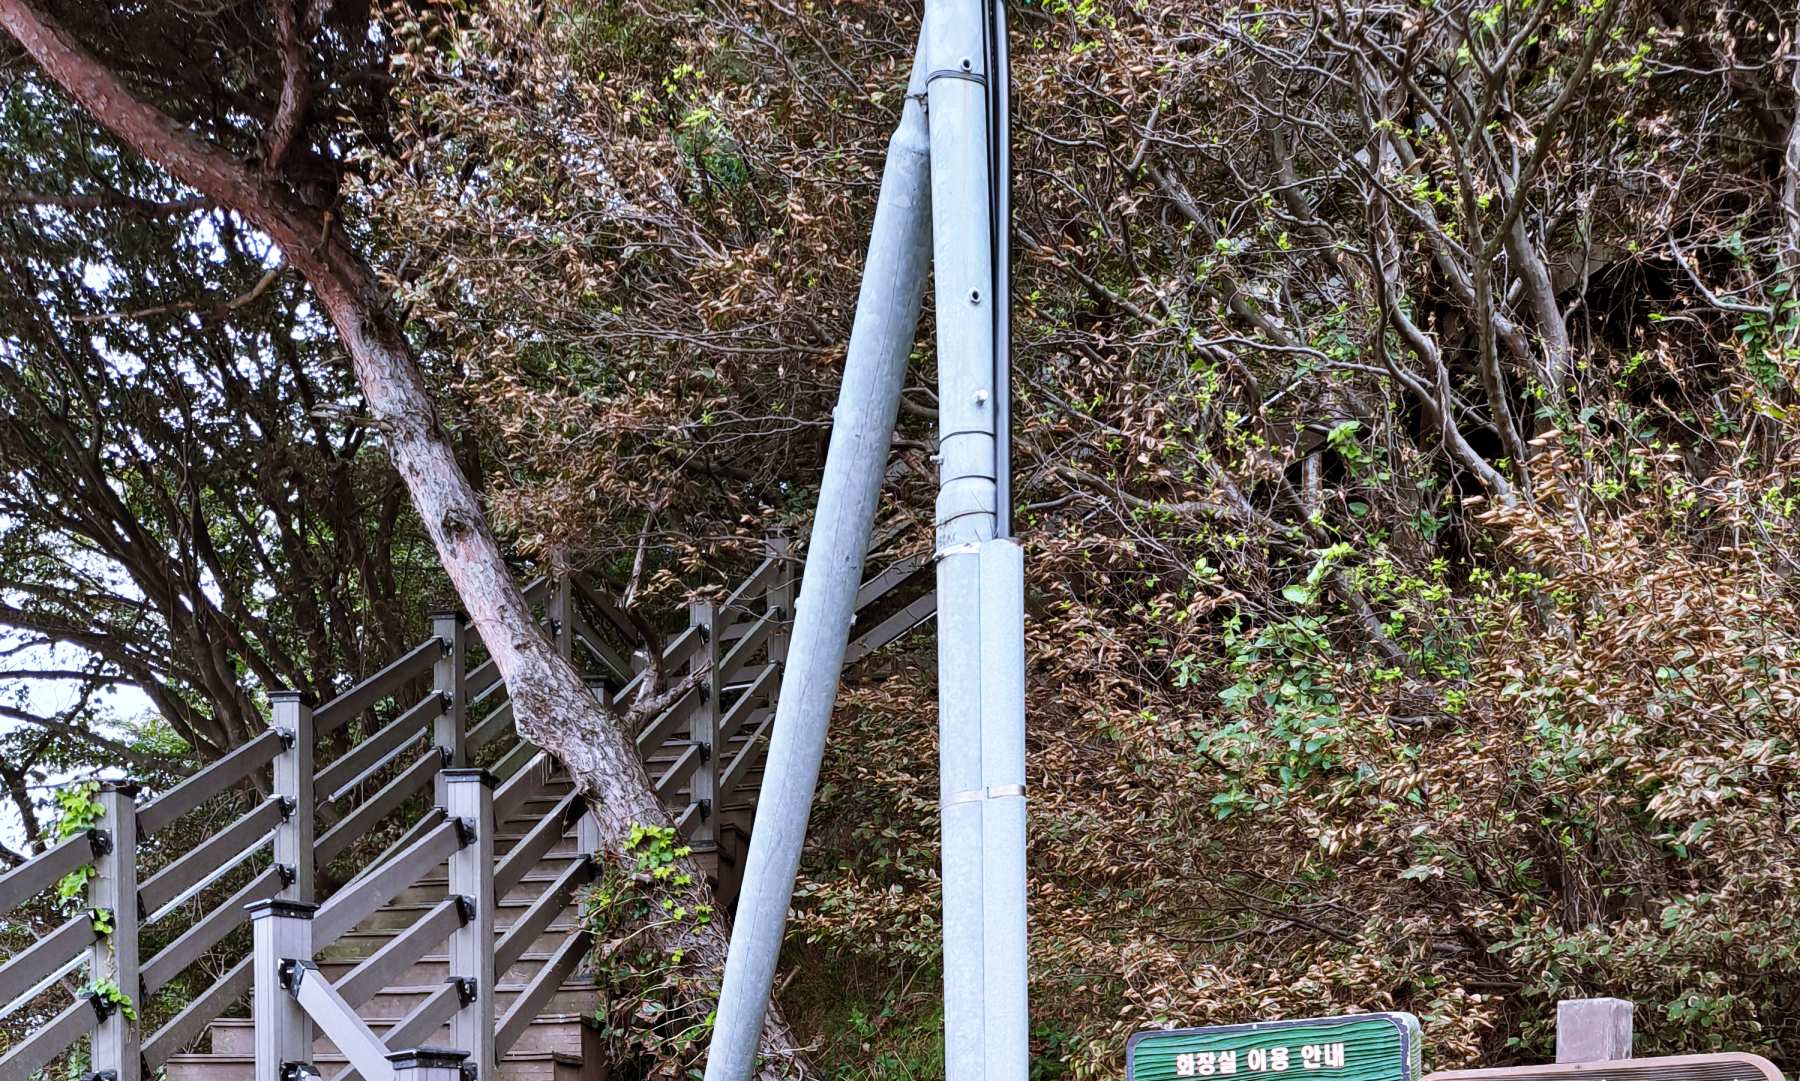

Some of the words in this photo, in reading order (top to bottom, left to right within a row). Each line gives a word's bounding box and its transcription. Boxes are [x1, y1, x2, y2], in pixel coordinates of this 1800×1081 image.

[1176, 1049, 1237, 1076] 화장실
[1248, 1047, 1289, 1072] 이용
[1301, 1042, 1345, 1068] 안내
